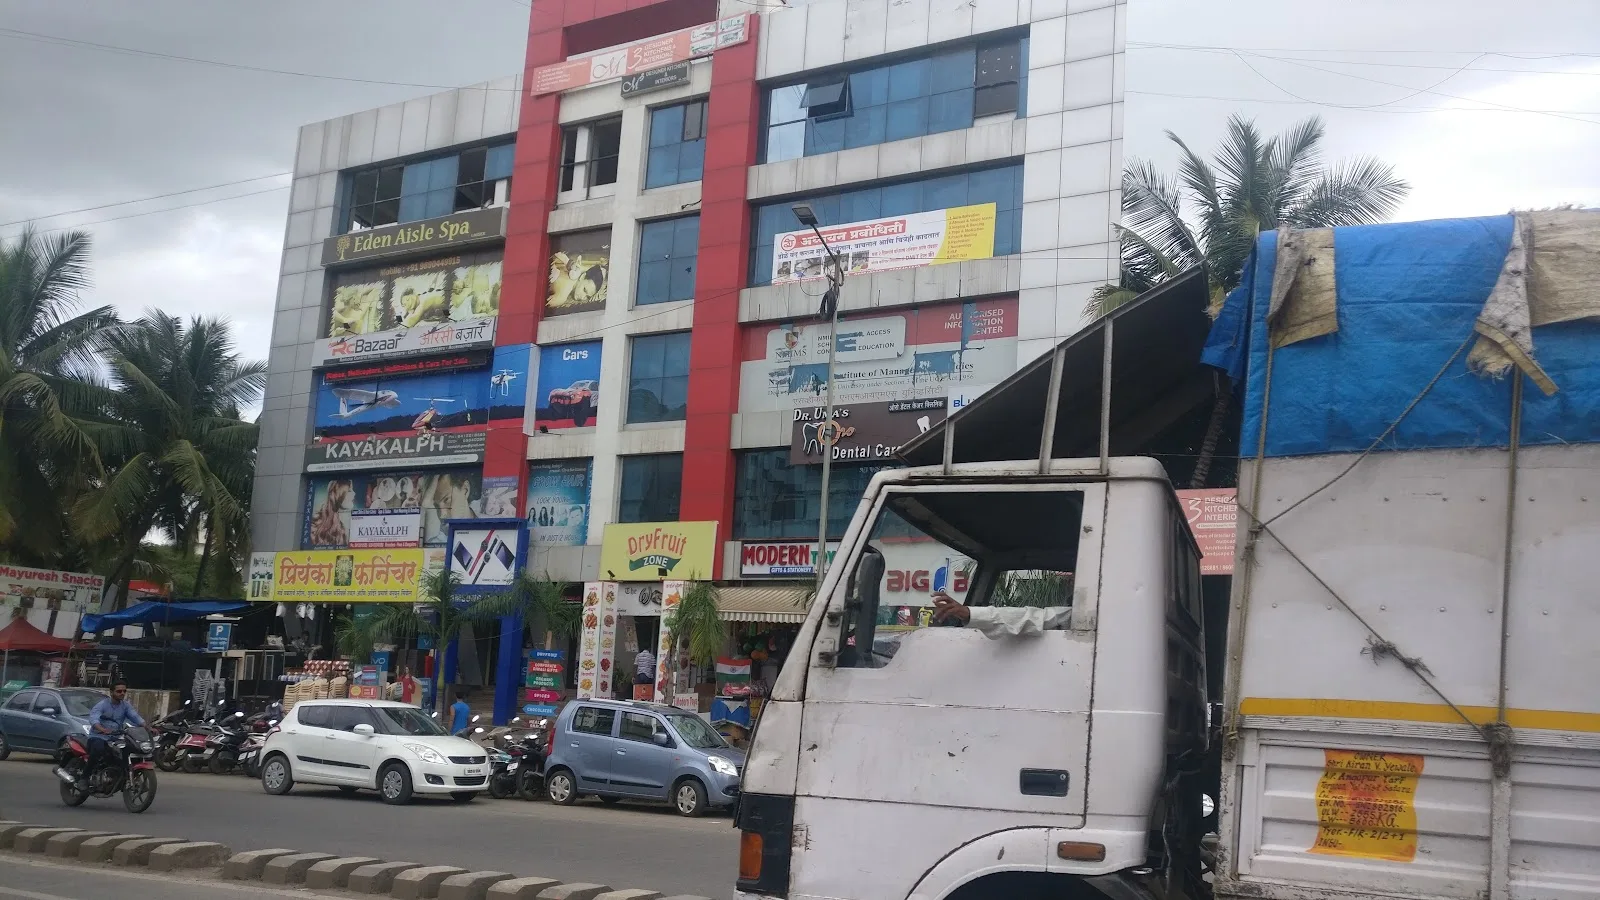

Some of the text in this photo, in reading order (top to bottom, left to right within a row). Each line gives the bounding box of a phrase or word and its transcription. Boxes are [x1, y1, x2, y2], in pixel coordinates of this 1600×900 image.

[353, 220, 470, 253] Eden Aisle Spa
[866, 328, 891, 336] ACCESS
[858, 342, 895, 351] EDUCATION
[563, 349, 588, 361] Cars
[868, 369, 877, 377] of
[325, 435, 445, 459] KAYAKALPH
[832, 445, 870, 459] Dental
[358, 525, 409, 537] KAYAKALPH
[643, 555, 669, 568] ZONE
[743, 544, 810, 567] MODERN
[278, 553, 417, 586] प्रियंका फर्निचर
[0, 566, 104, 587] Mayuresh Snacks
[1345, 760, 1371, 770] Kiran
